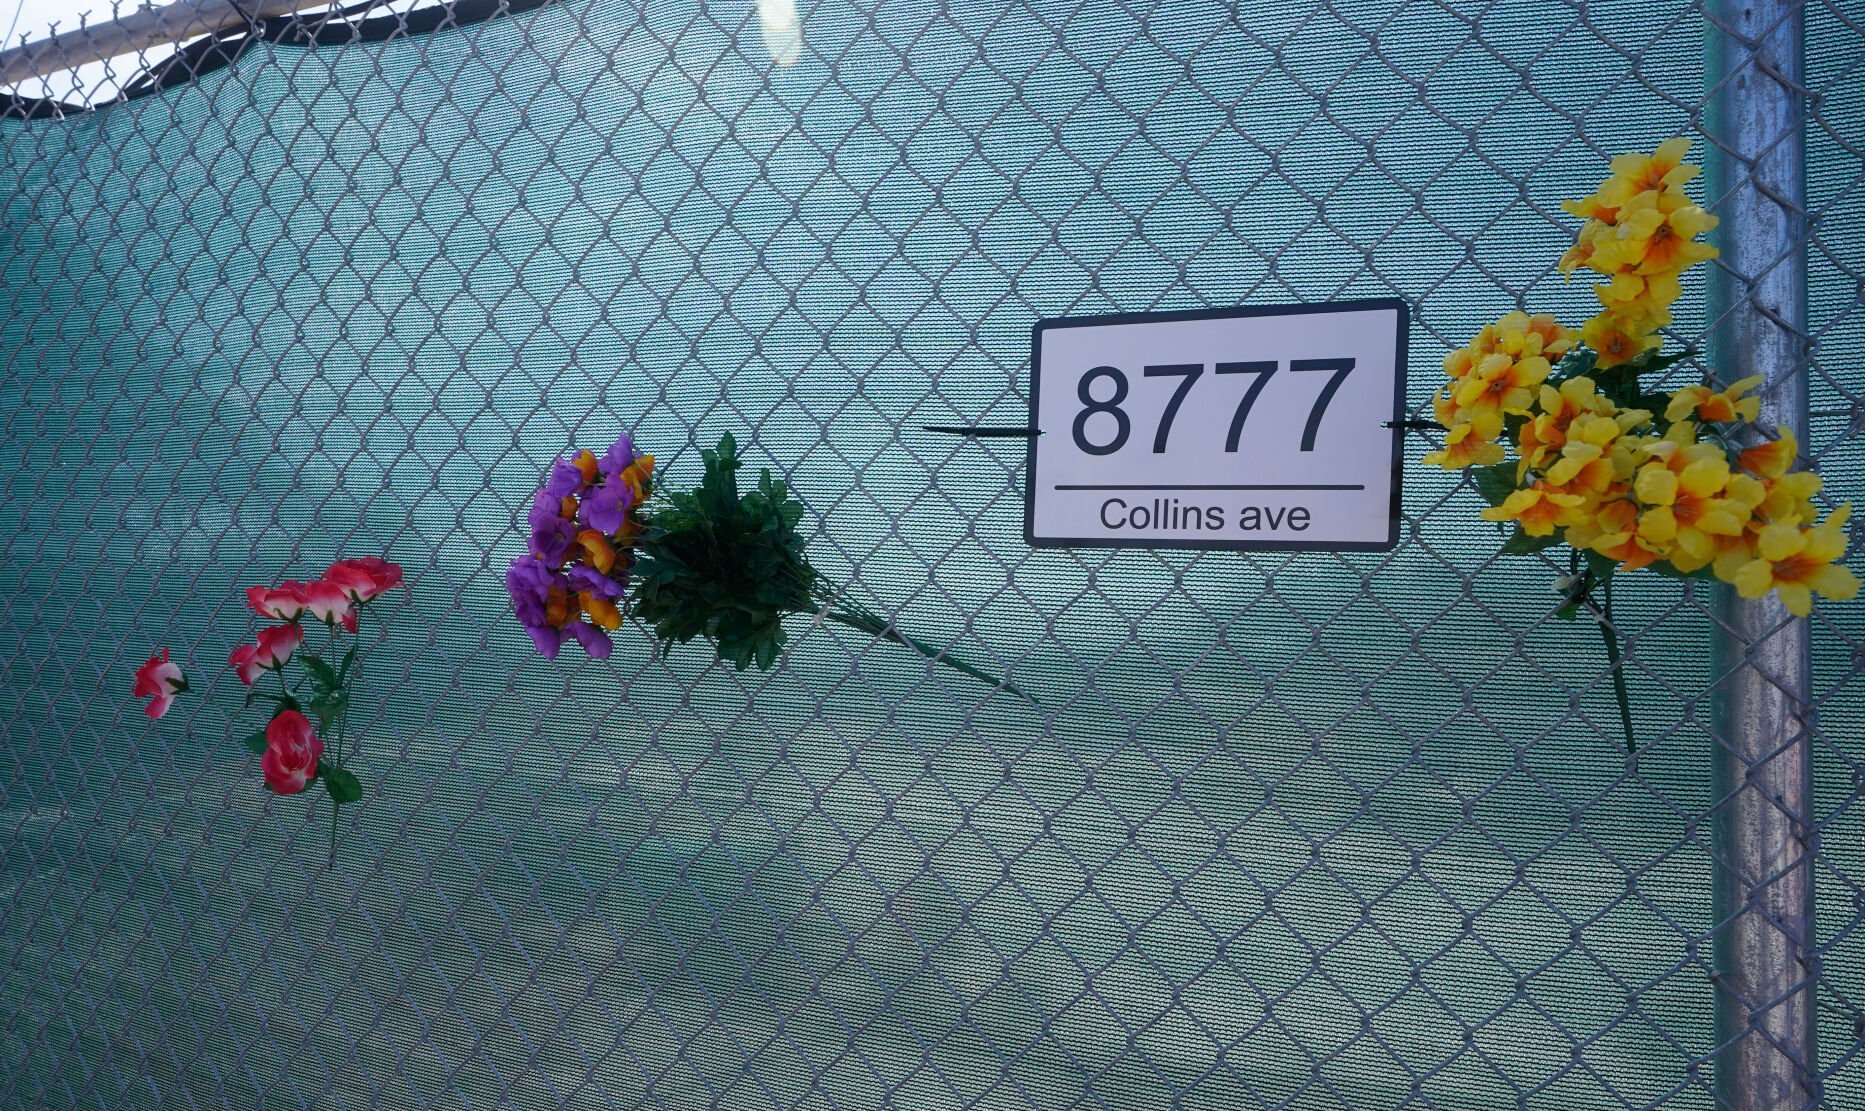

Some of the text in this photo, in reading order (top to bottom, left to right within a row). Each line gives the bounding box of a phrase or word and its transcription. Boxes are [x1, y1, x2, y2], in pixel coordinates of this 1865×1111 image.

[1072, 358, 1356, 456] 8777
[1100, 498, 1311, 532] Collins ave
